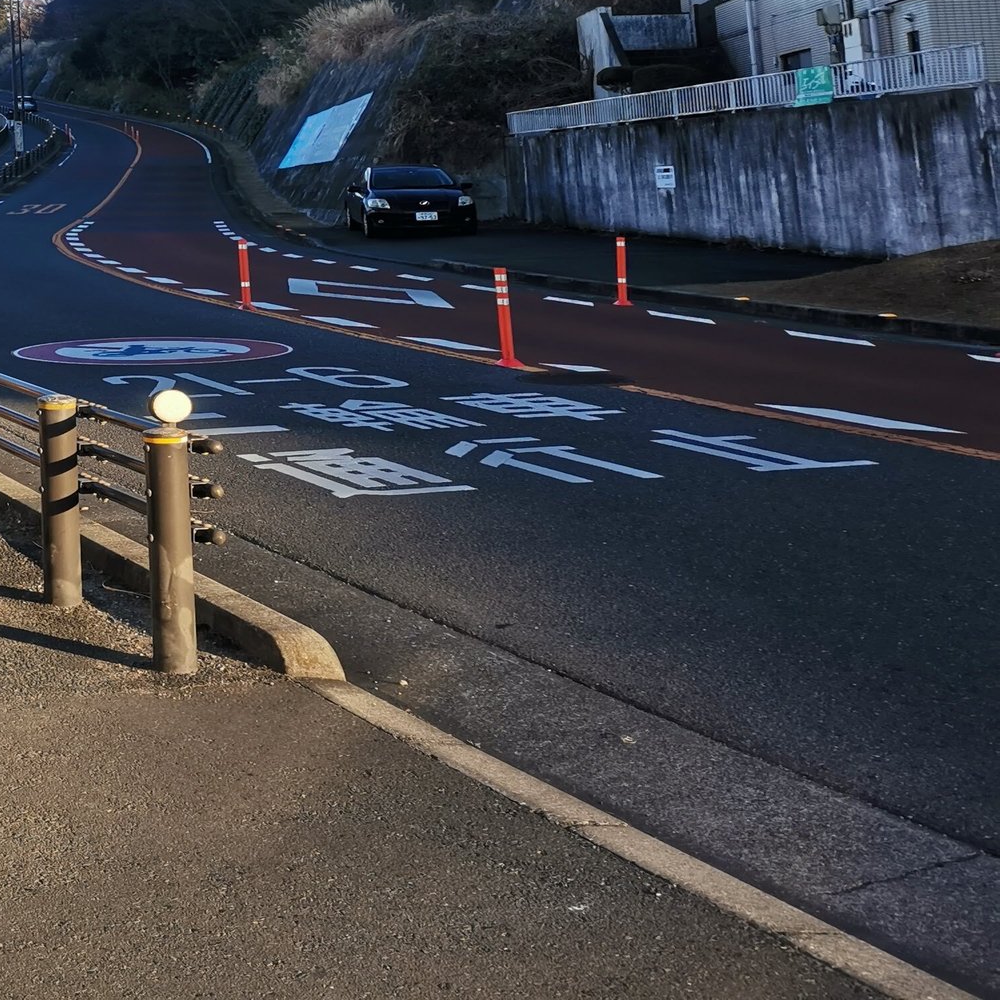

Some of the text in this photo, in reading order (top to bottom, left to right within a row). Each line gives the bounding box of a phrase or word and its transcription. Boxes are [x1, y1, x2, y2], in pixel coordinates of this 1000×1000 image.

[6, 203, 67, 215] 30
[102, 366, 410, 398] 21-6
[236, 430, 880, 498] 通行止
